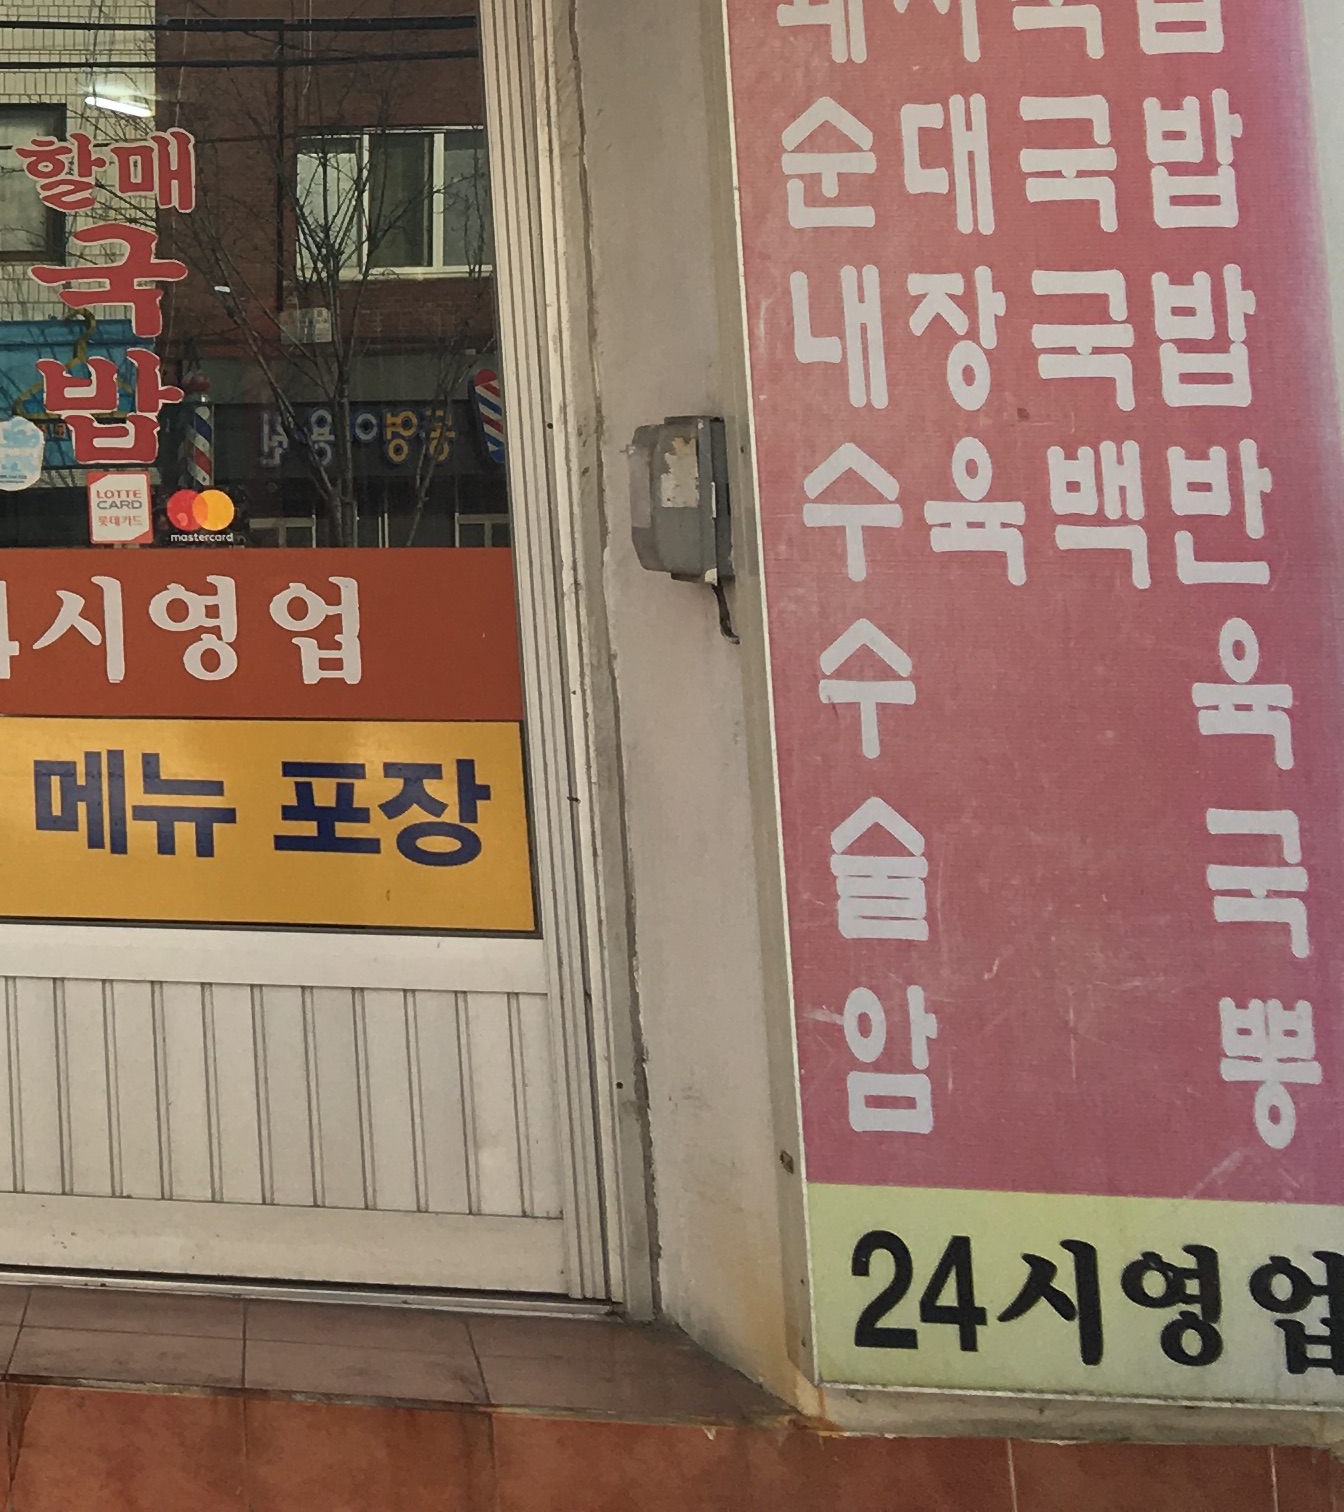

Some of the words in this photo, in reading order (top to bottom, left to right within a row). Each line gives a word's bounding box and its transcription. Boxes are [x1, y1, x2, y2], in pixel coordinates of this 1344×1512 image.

[16, 127, 195, 213] 할매
[780, 88, 1244, 236] 순대국밥
[791, 262, 1258, 411] 내장국밥
[96, 489, 142, 499] LOTTE
[96, 500, 143, 510] CARD
[97, 515, 144, 527] 롯데카드
[170, 532, 234, 542] mastercard
[802, 436, 1274, 590] 수육백반
[33, 748, 237, 859] 메뉴
[273, 757, 492, 868] 포장
[849, 1229, 1344, 1377] 24시영업
